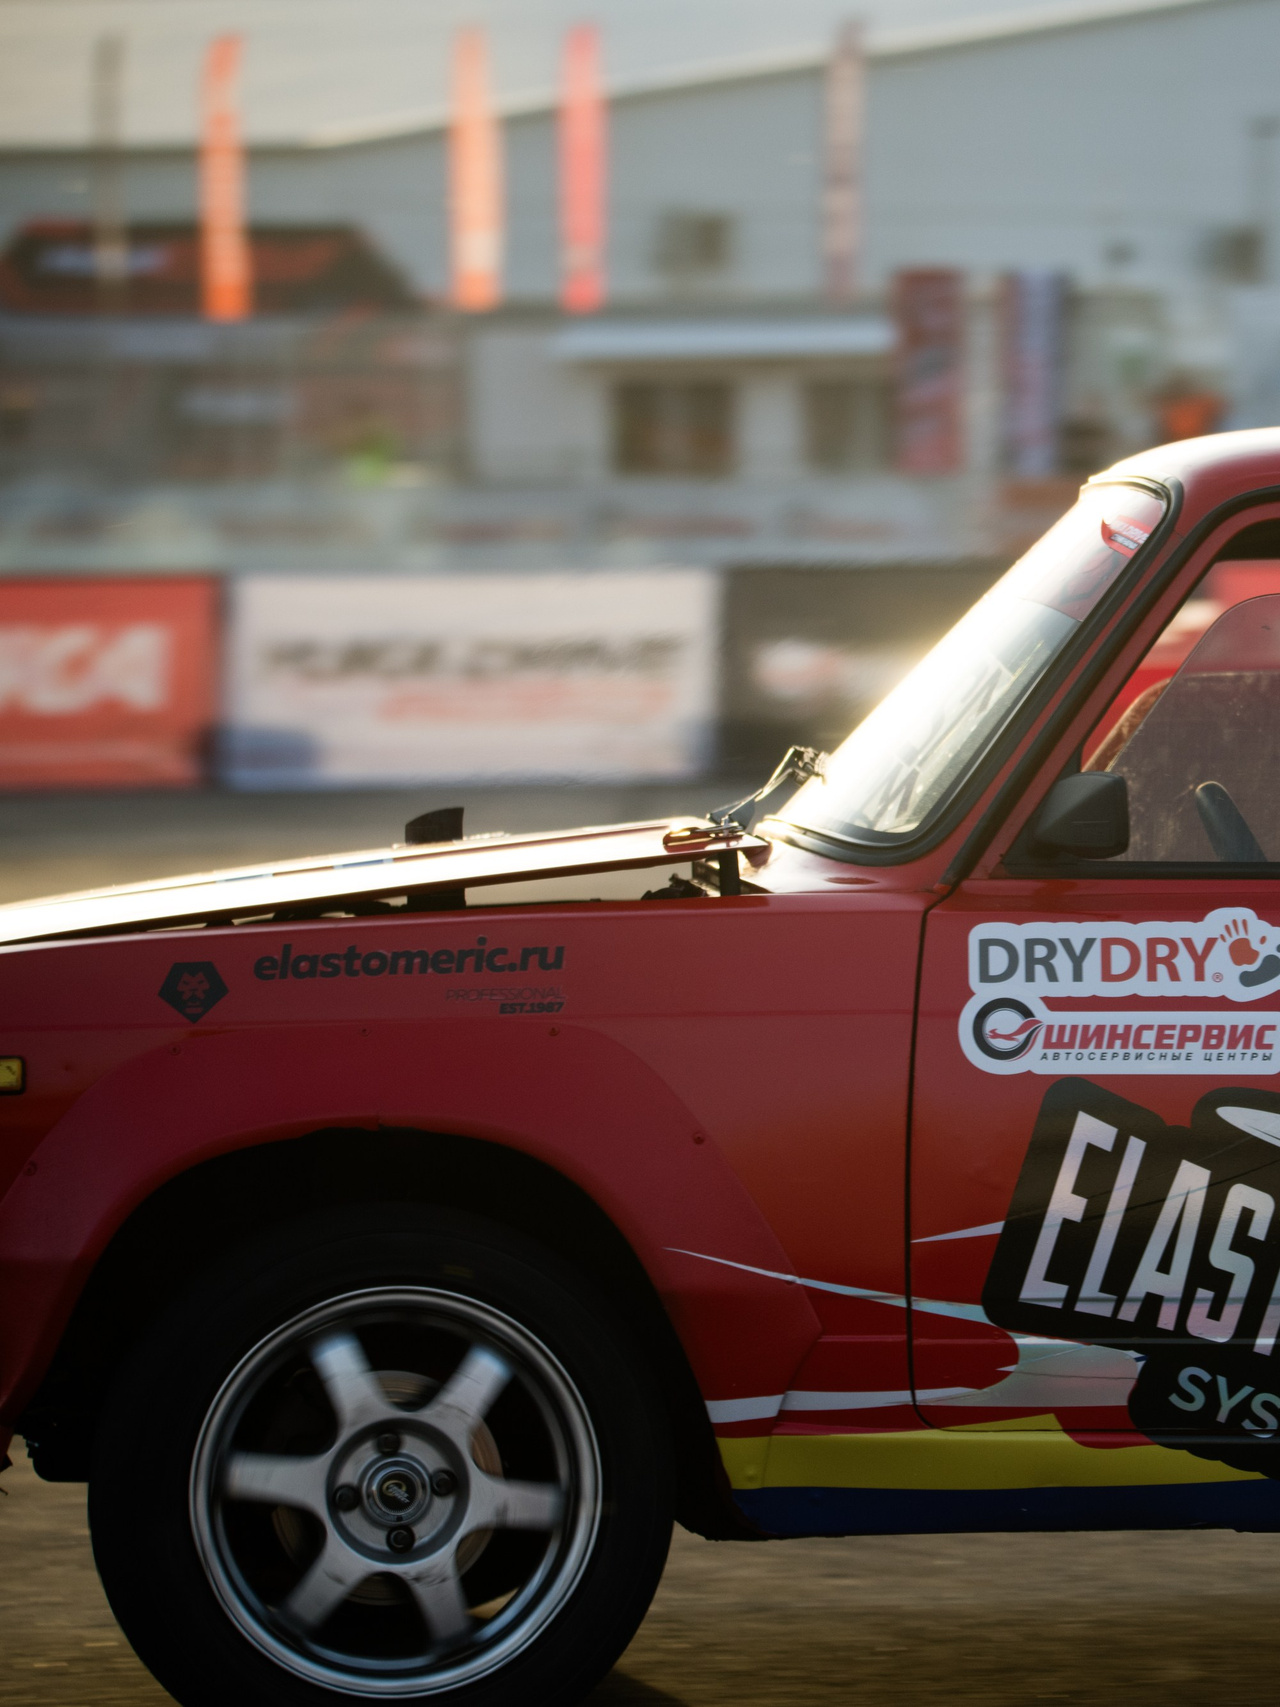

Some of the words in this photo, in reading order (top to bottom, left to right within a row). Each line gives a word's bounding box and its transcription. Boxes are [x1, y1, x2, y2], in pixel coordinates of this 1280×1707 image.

[253, 936, 566, 980] elastomeric.ru
[977, 936, 1220, 984] DRYDRY
[445, 986, 566, 1002] PROFESSIONAL
[1042, 1024, 1278, 1050] ШИНСЕРВИС
[1040, 1051, 1194, 1062] АВТОСЕРВИСНЫЕ
[1203, 1051, 1273, 1062] ЦЕНТРЫ
